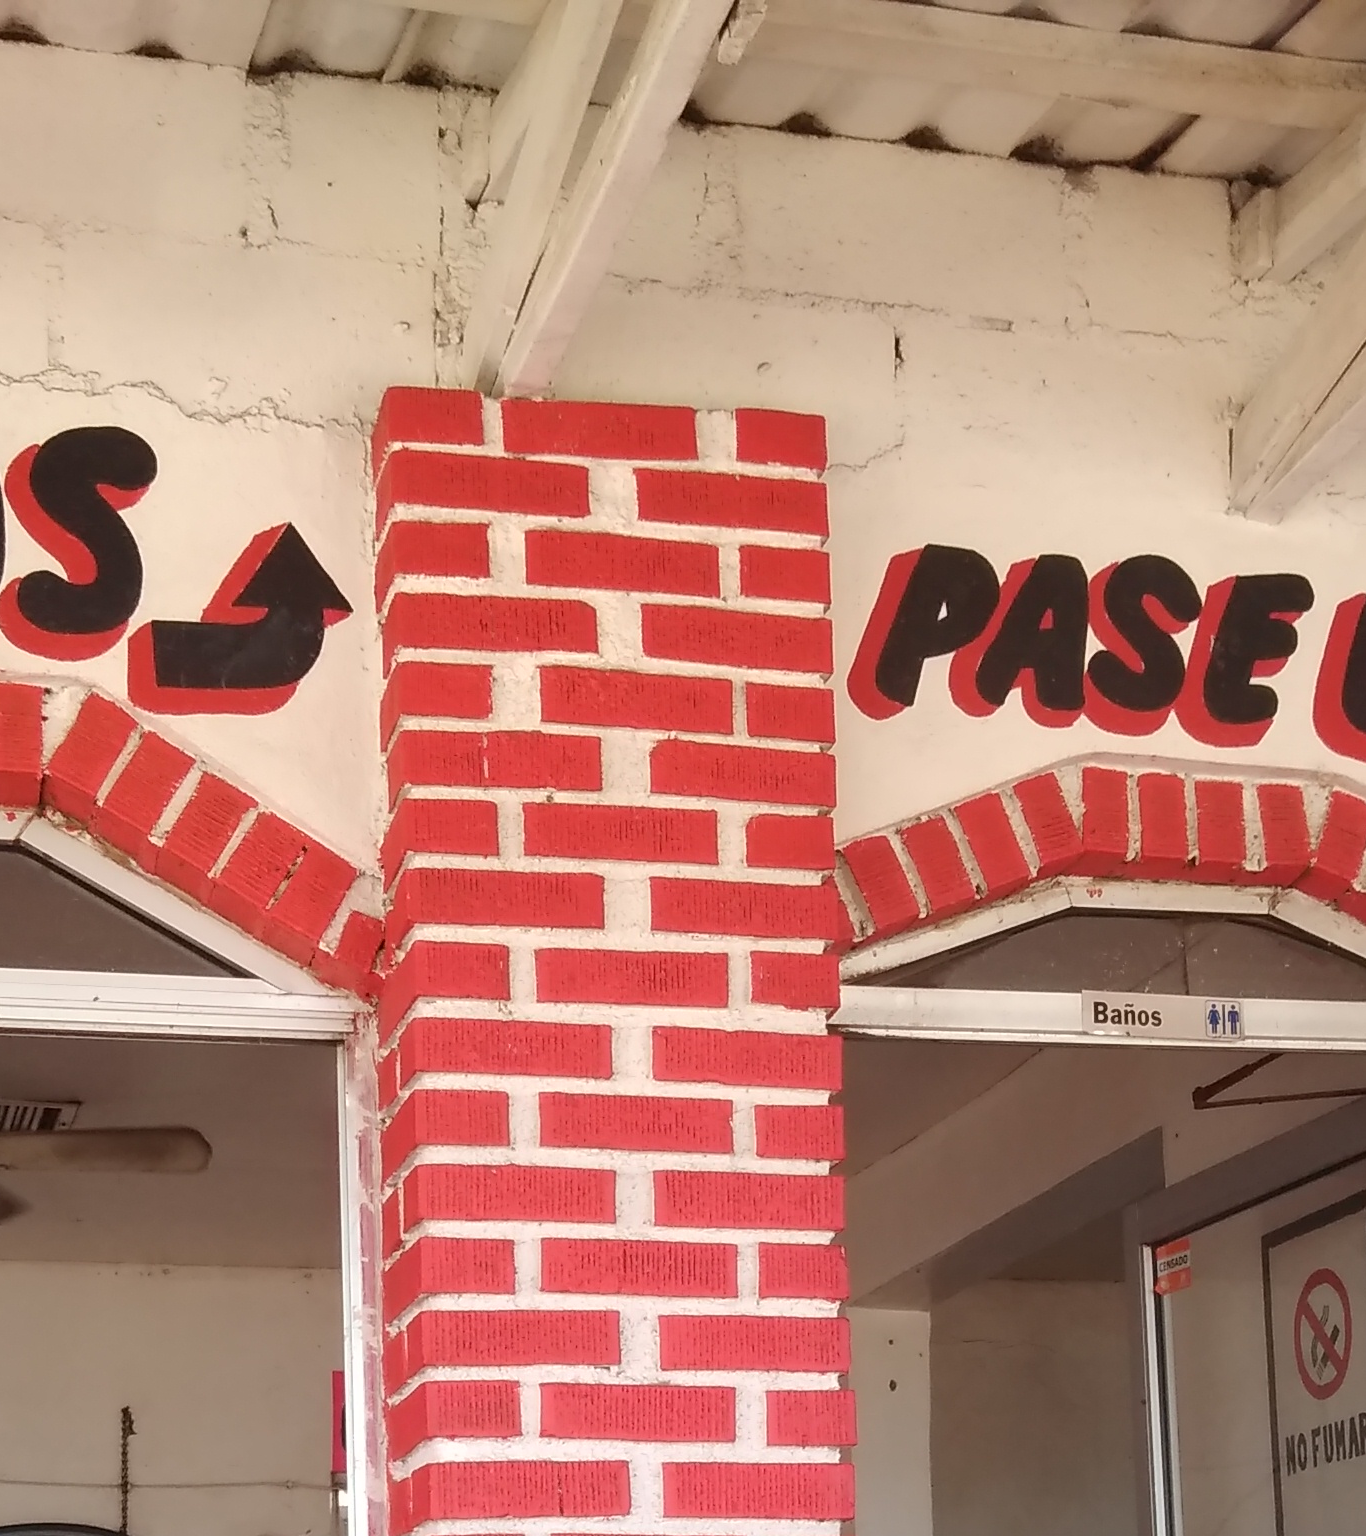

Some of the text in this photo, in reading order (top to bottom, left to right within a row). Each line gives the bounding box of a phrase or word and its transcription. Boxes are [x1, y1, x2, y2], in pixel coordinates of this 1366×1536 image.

[847, 544, 1315, 748] PASE
[1093, 1001, 1162, 1028] Baños
[1159, 1254, 1188, 1272] CENSADO
[1285, 1434, 1308, 1477] NO
